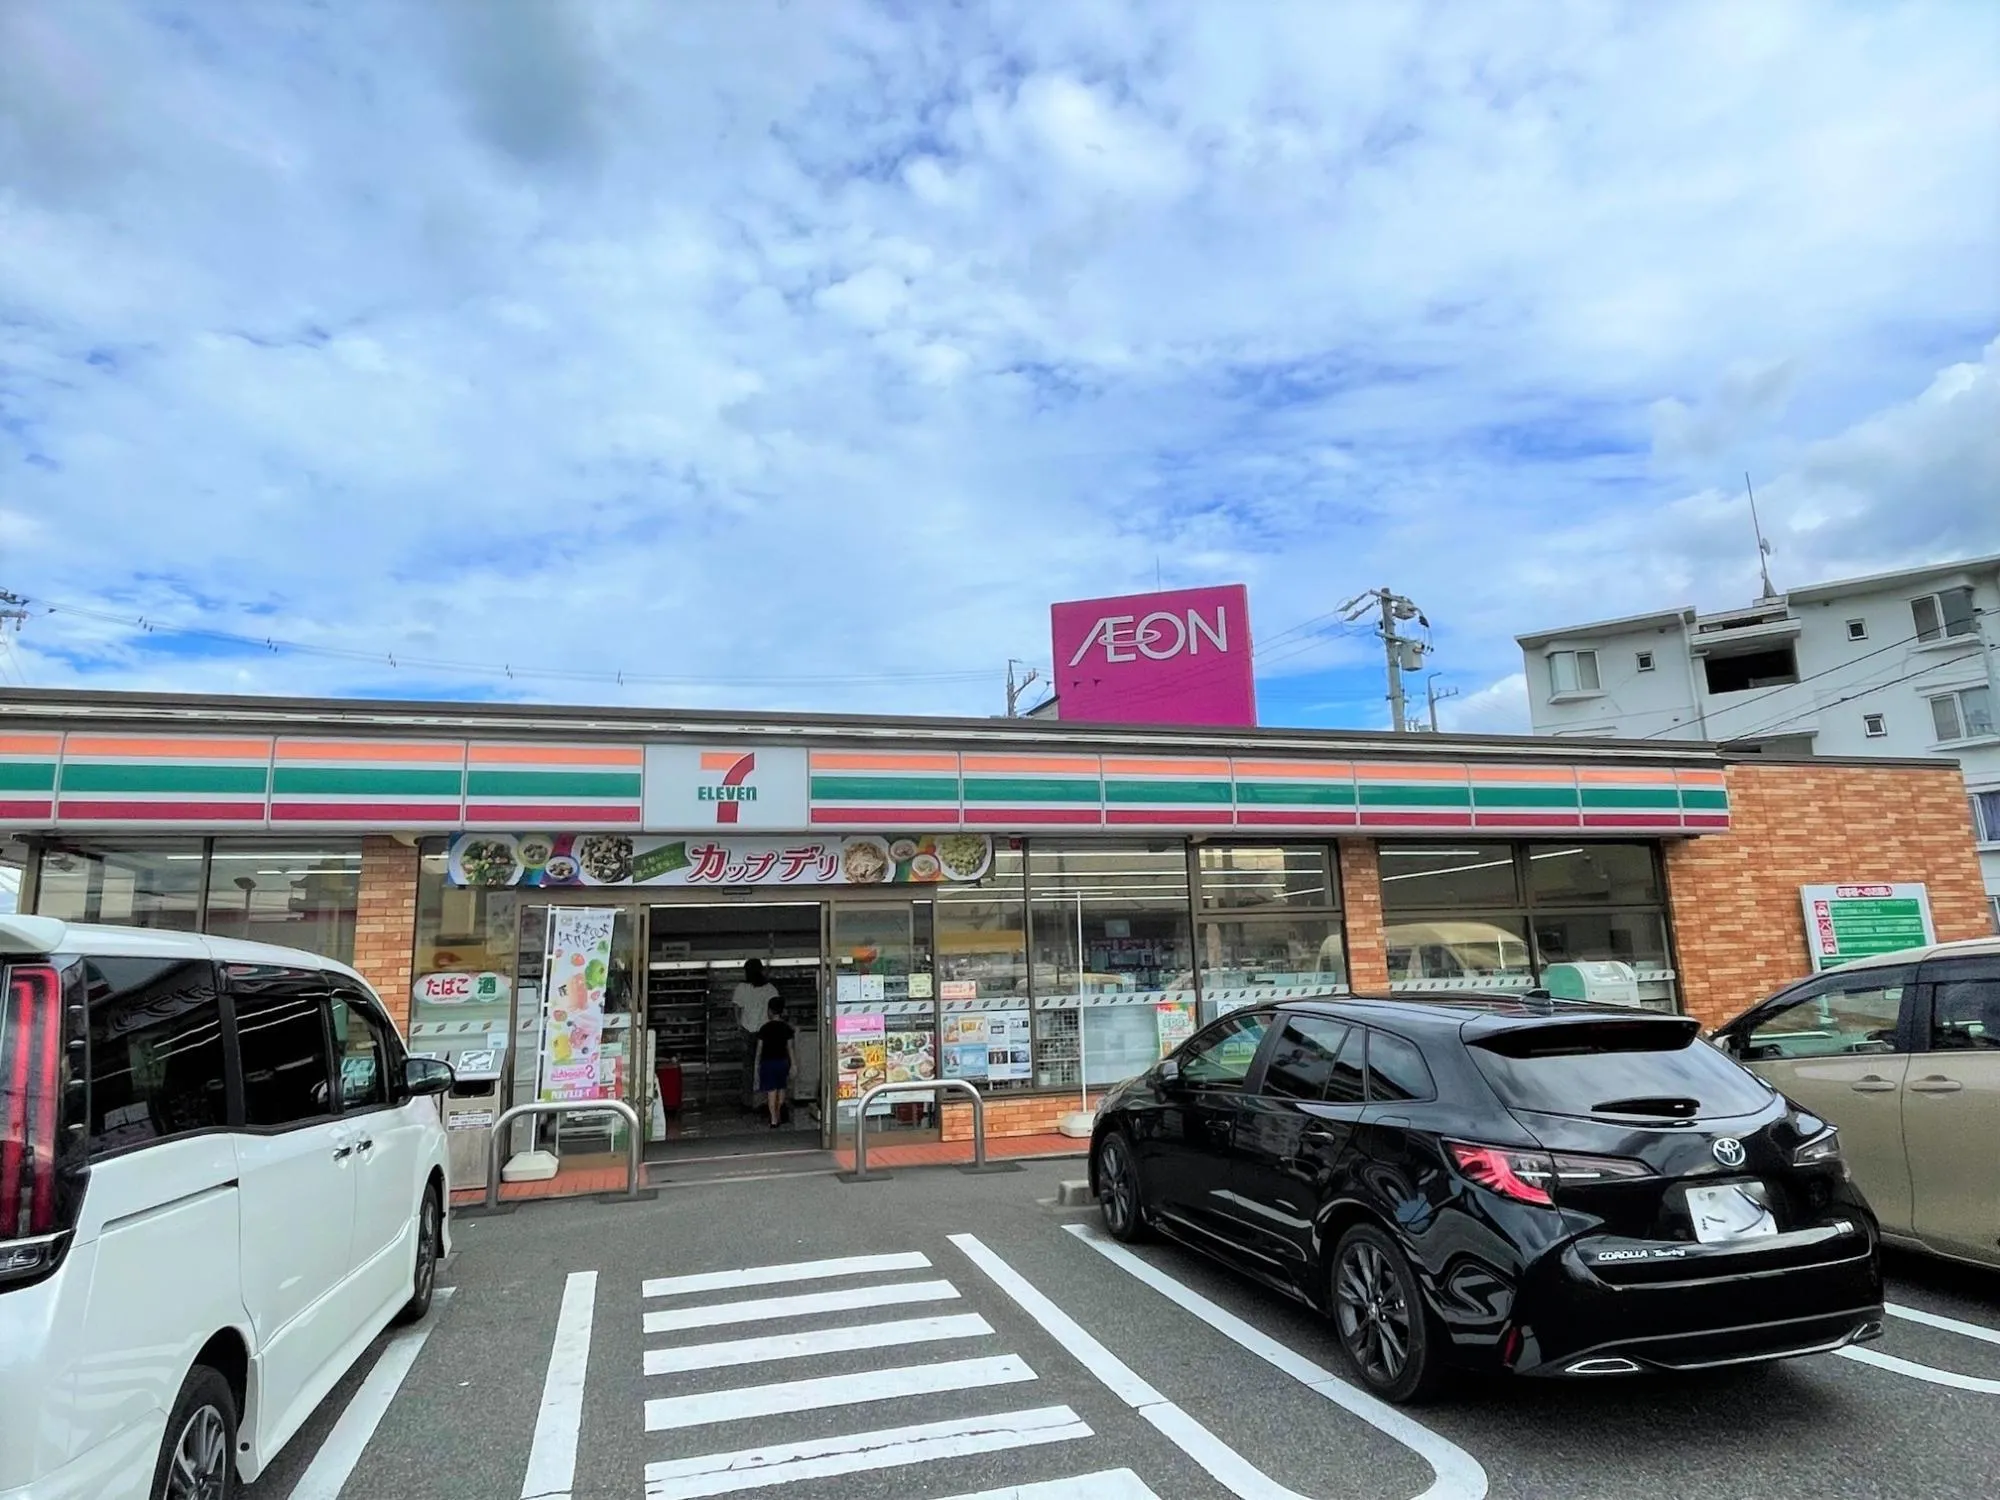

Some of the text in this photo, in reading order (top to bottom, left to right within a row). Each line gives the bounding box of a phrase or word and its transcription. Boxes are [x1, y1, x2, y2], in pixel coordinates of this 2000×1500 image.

[701, 752, 755, 823] 7
[688, 842, 838, 882] カップデリ
[426, 976, 497, 996] たばこ 酒
[1598, 1250, 1649, 1261] COROLLA
